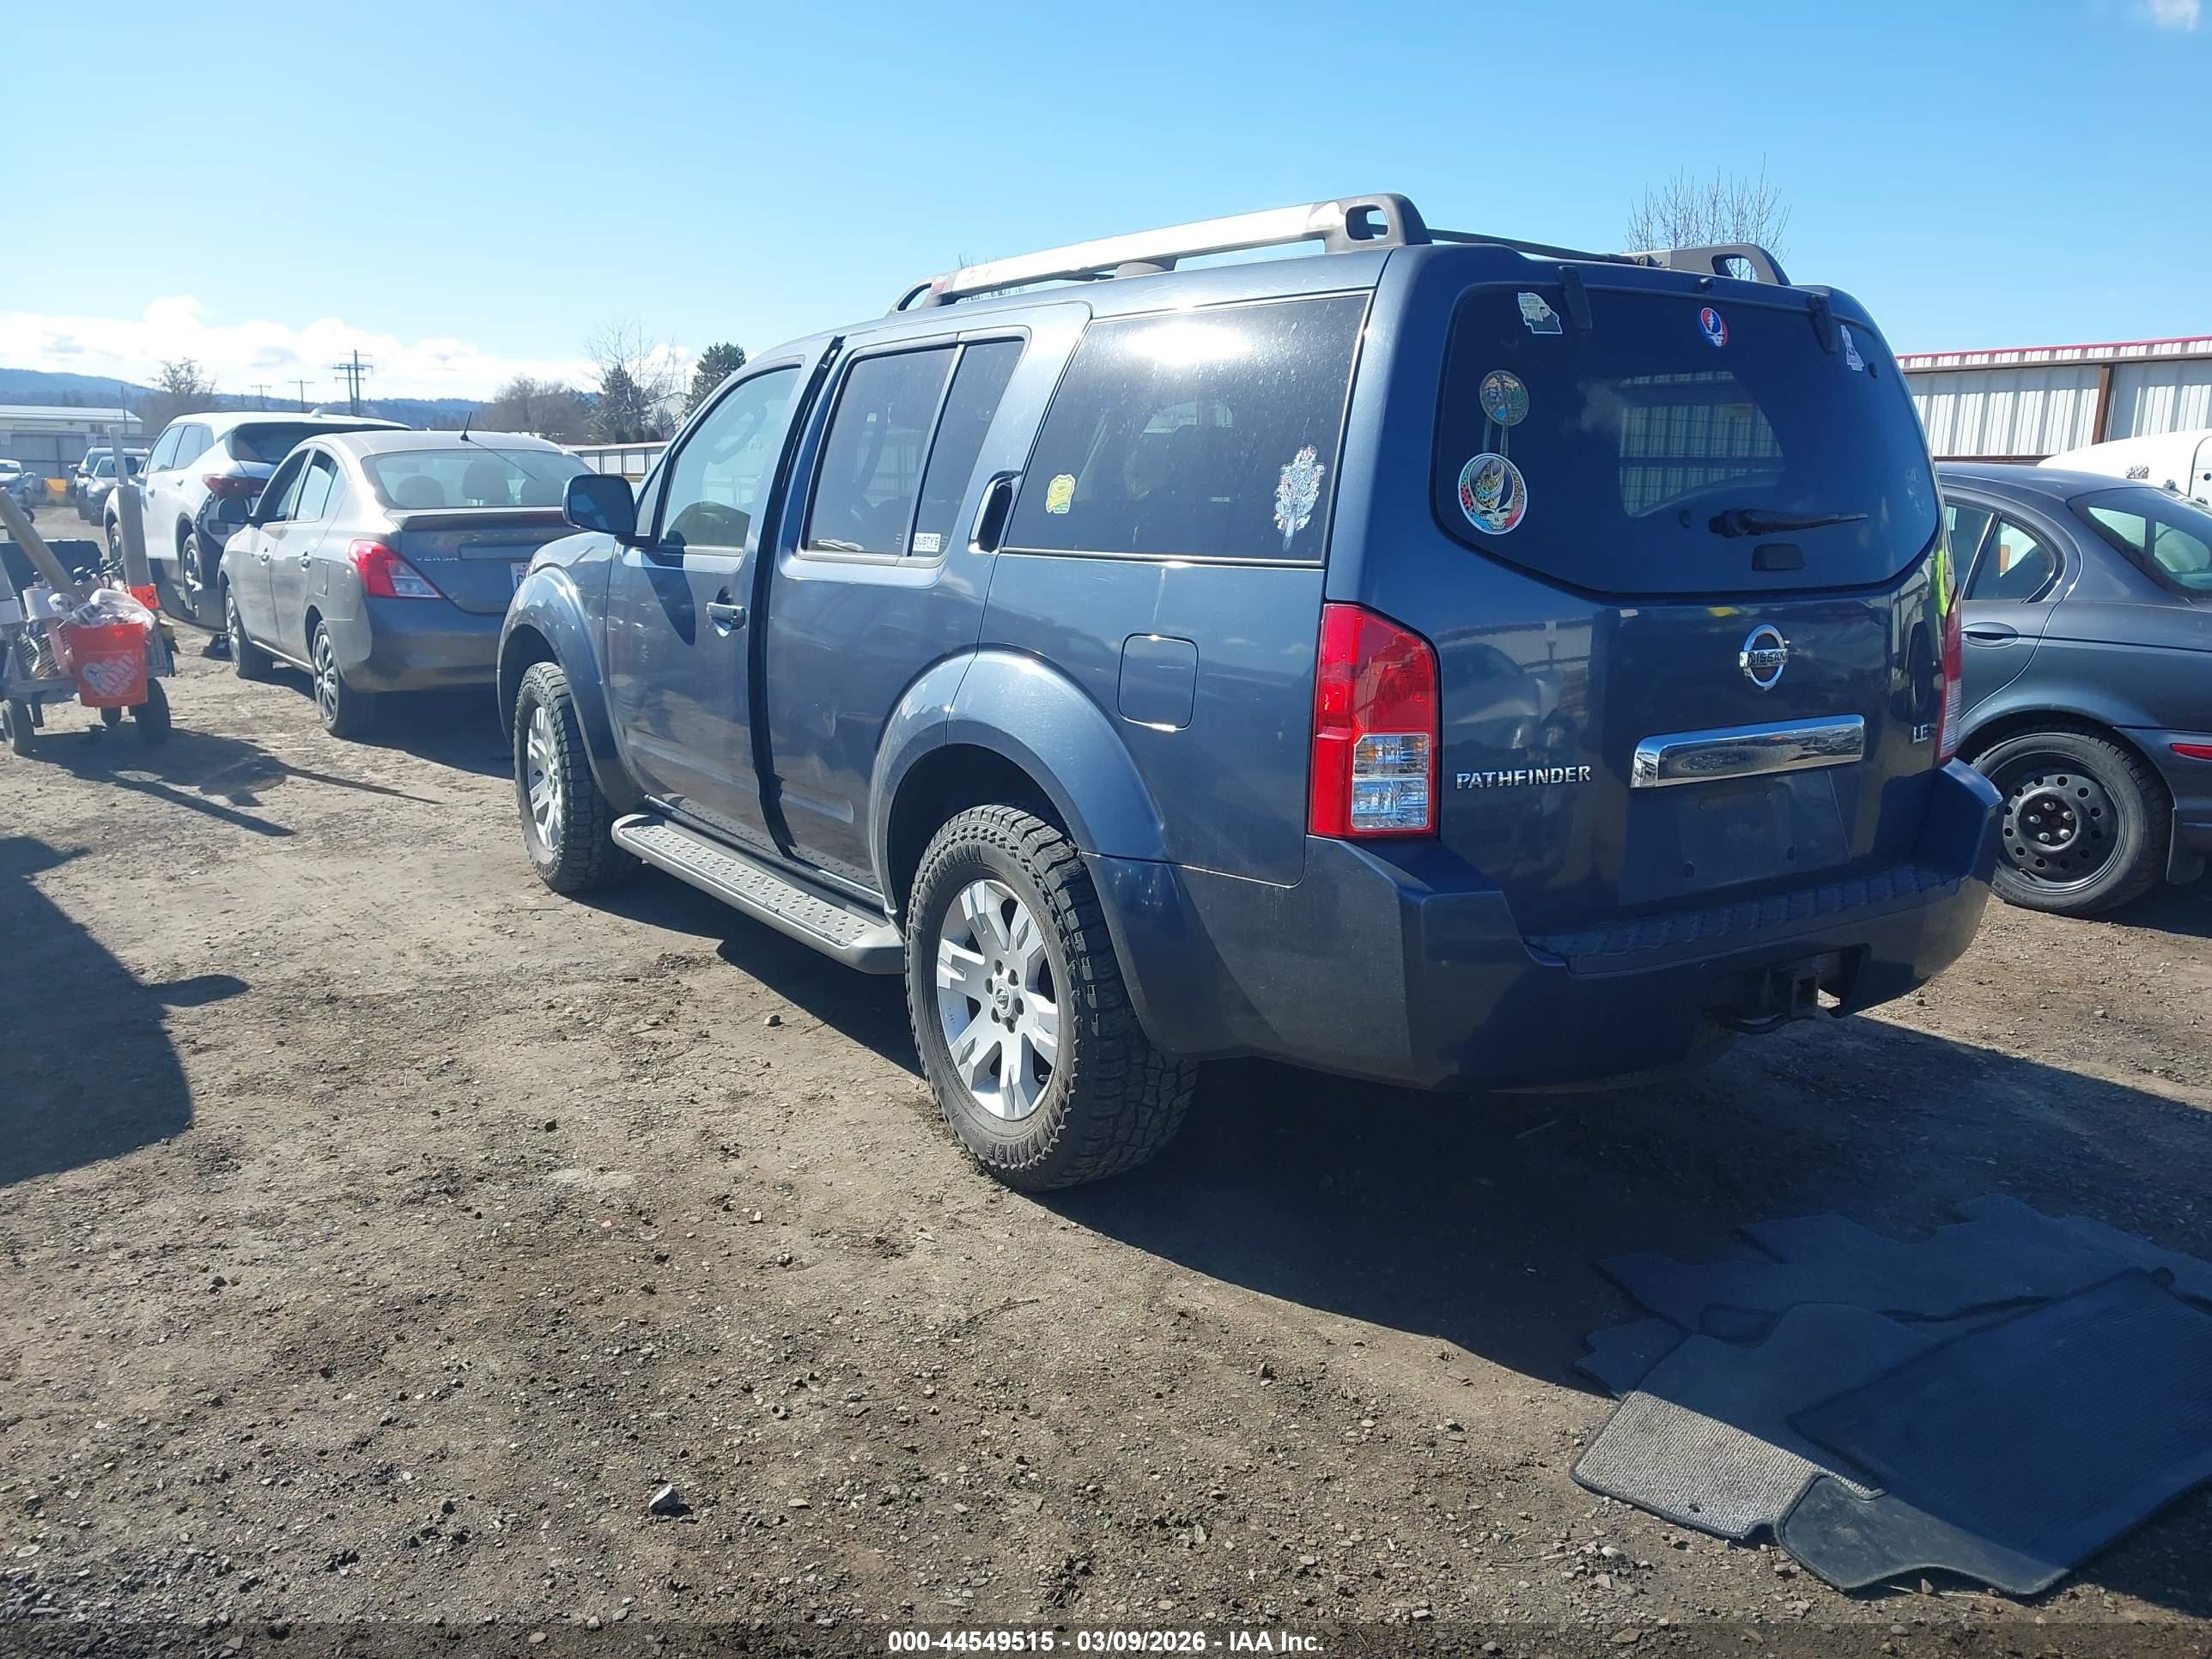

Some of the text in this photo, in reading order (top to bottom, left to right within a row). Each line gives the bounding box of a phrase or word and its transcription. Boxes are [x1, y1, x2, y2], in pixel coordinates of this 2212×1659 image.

[1748, 652, 1787, 664] NISSAN
[1912, 723, 1929, 744] LE
[1455, 765, 1592, 790] PATHFINDER
